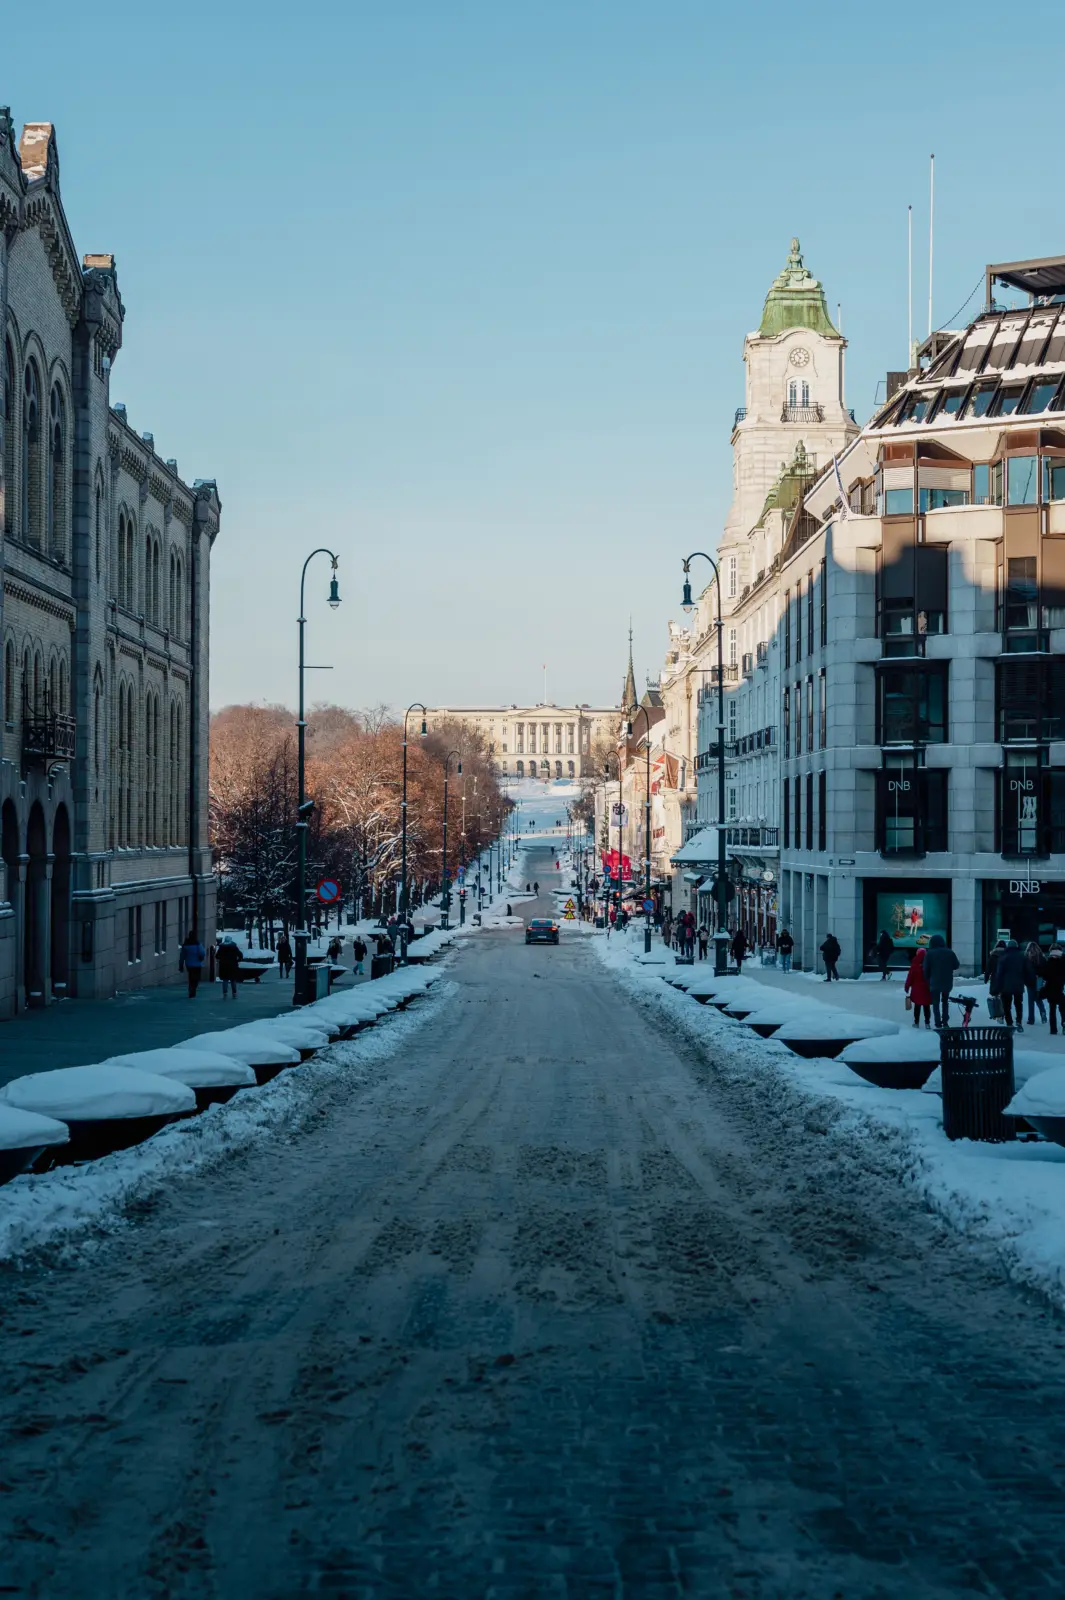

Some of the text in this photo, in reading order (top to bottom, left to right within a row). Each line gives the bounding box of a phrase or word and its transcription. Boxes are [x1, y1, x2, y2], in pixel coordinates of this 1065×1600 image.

[888, 780, 911, 791] DNB
[1010, 780, 1034, 791] DNB
[1009, 880, 1040, 894] DNB
